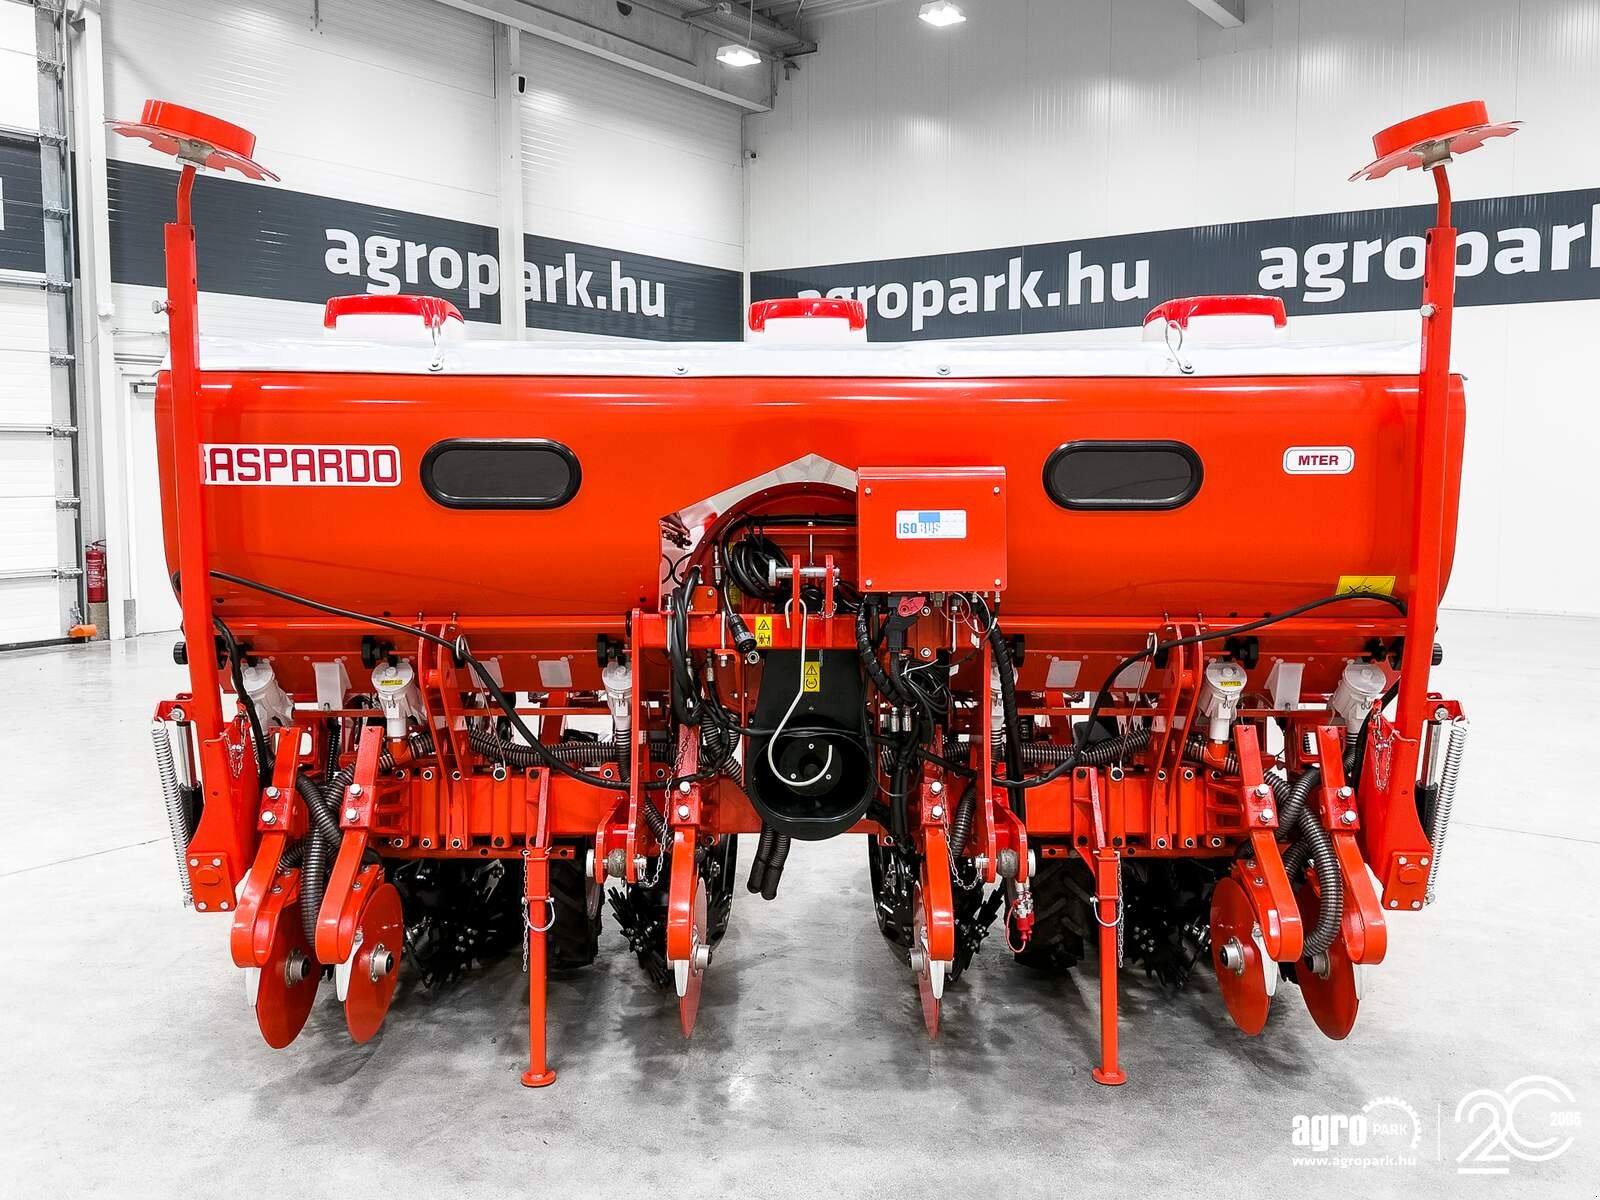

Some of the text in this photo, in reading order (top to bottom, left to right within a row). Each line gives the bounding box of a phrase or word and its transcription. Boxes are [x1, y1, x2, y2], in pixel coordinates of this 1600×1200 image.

[797, 250, 1150, 332] ropark.hu
[1257, 203, 1600, 303] agropar
[1298, 455, 1339, 466] MTER
